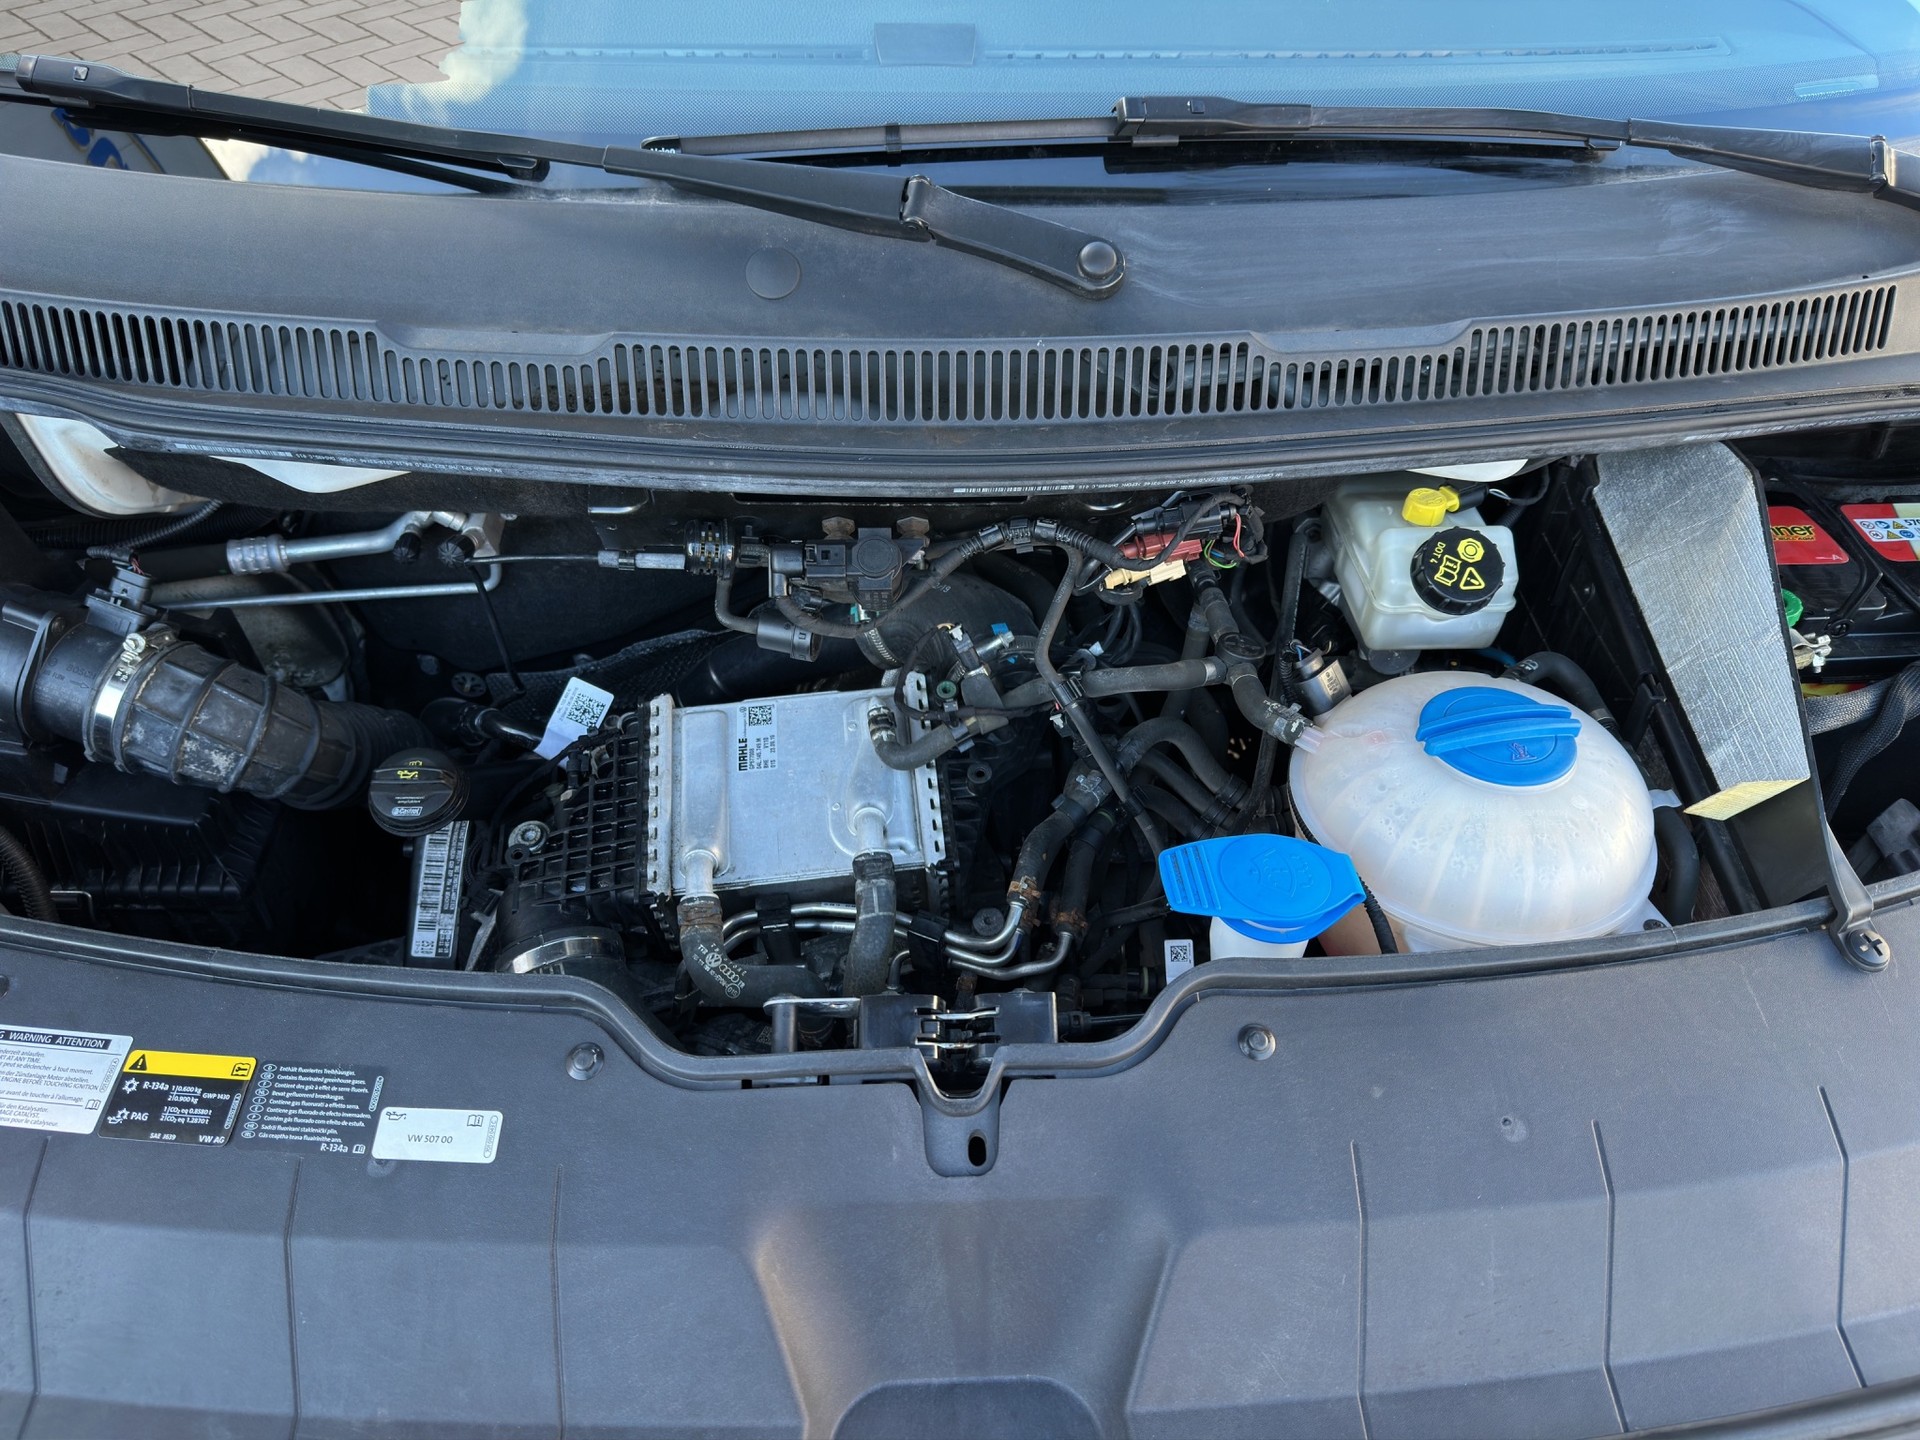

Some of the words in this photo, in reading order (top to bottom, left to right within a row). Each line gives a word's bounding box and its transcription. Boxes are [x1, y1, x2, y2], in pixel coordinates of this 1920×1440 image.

[1433, 541, 1446, 559] DOT
[738, 738, 748, 771] MAHLE
[9, 1032, 53, 1044] WARNING
[55, 1036, 105, 1048] ATTENTION
[44, 1080, 73, 1088] TOUCHING
[142, 1081, 170, 1091] R-134a
[130, 1112, 149, 1121] PAG
[150, 1132, 162, 1140] SAE
[199, 1134, 214, 1143] VW
[214, 1136, 226, 1144] AG
[407, 1134, 423, 1142] VW
[424, 1134, 439, 1143] 507
[440, 1135, 453, 1144] 00
[320, 1143, 349, 1153] R-134a
